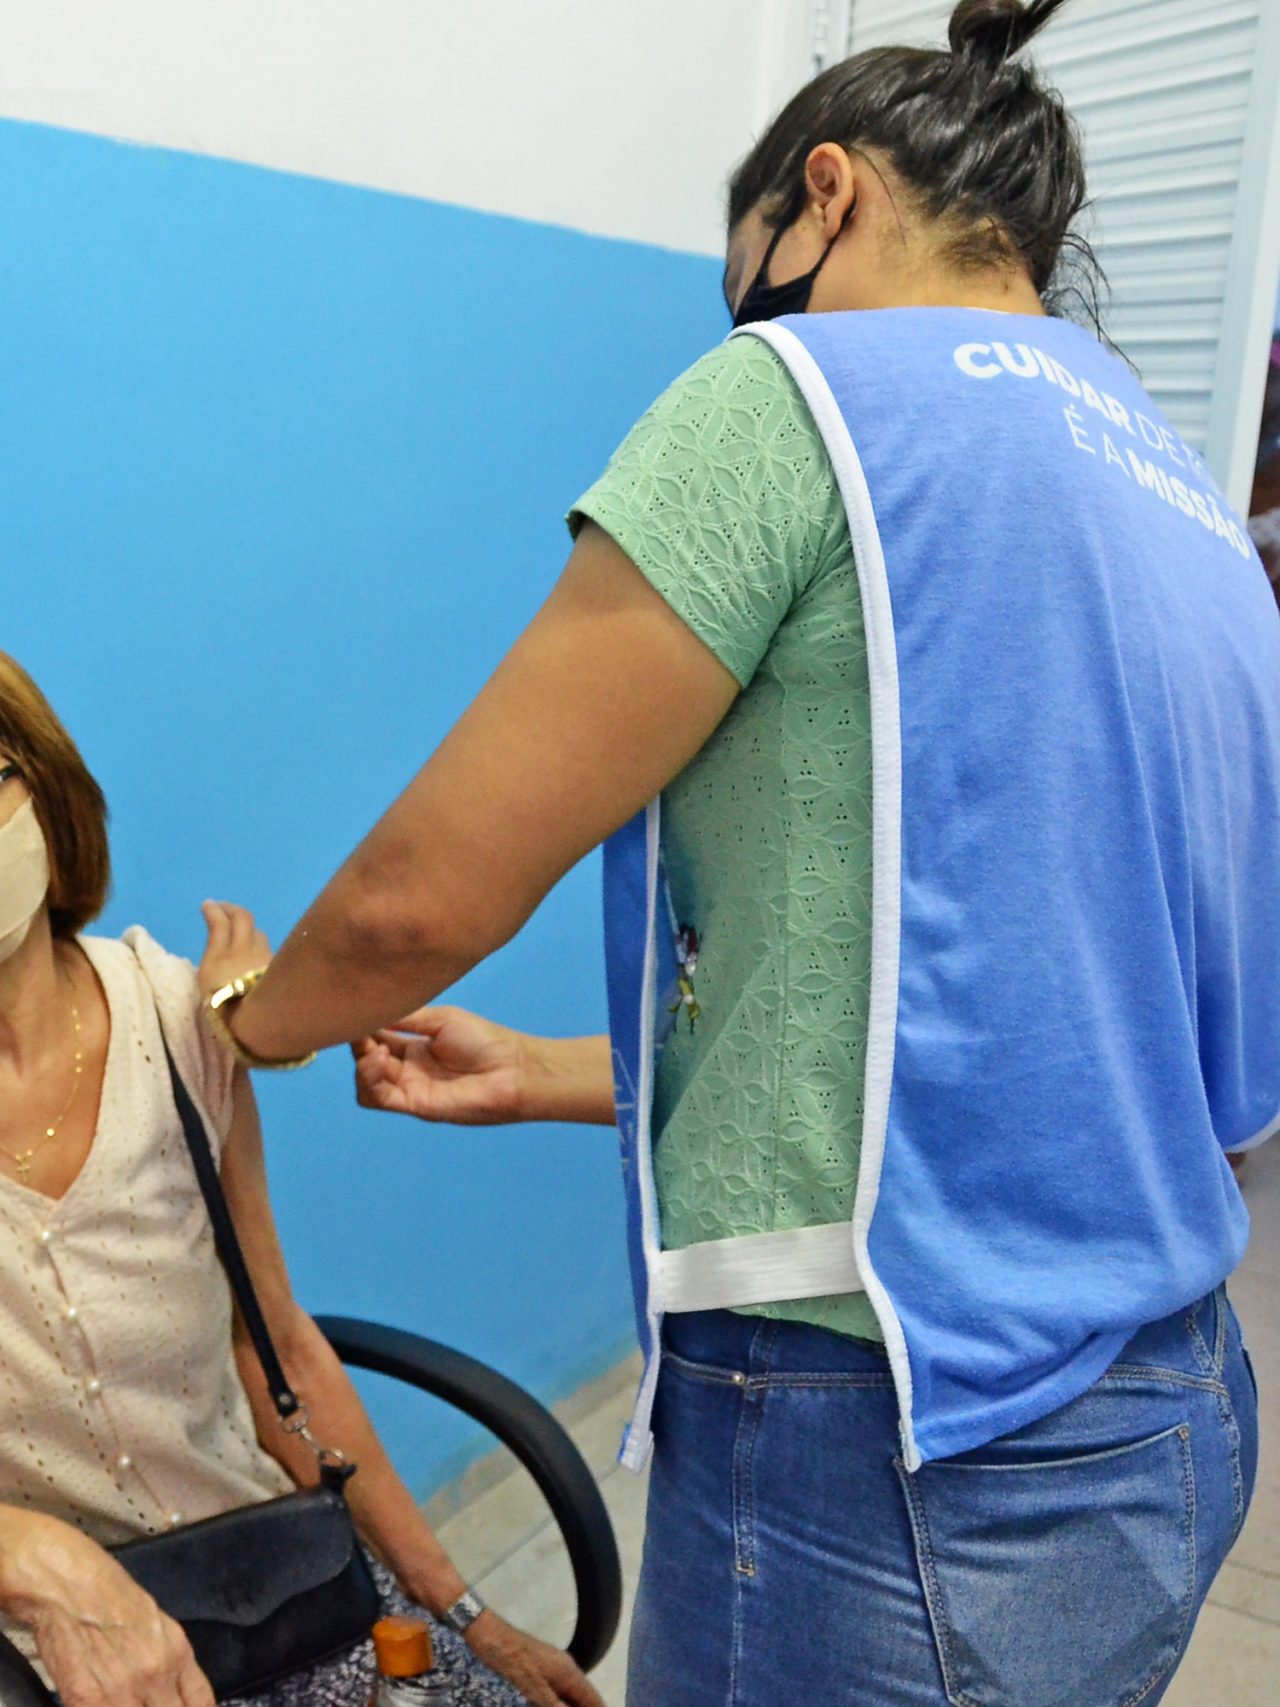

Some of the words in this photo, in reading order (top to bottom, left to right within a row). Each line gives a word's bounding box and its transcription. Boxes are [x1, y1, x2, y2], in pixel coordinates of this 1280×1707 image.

[953, 341, 1136, 436] CUIDAR
[1063, 403, 1096, 455] É
[1103, 432, 1130, 478] A
[1125, 447, 1251, 560] MISSÃO
